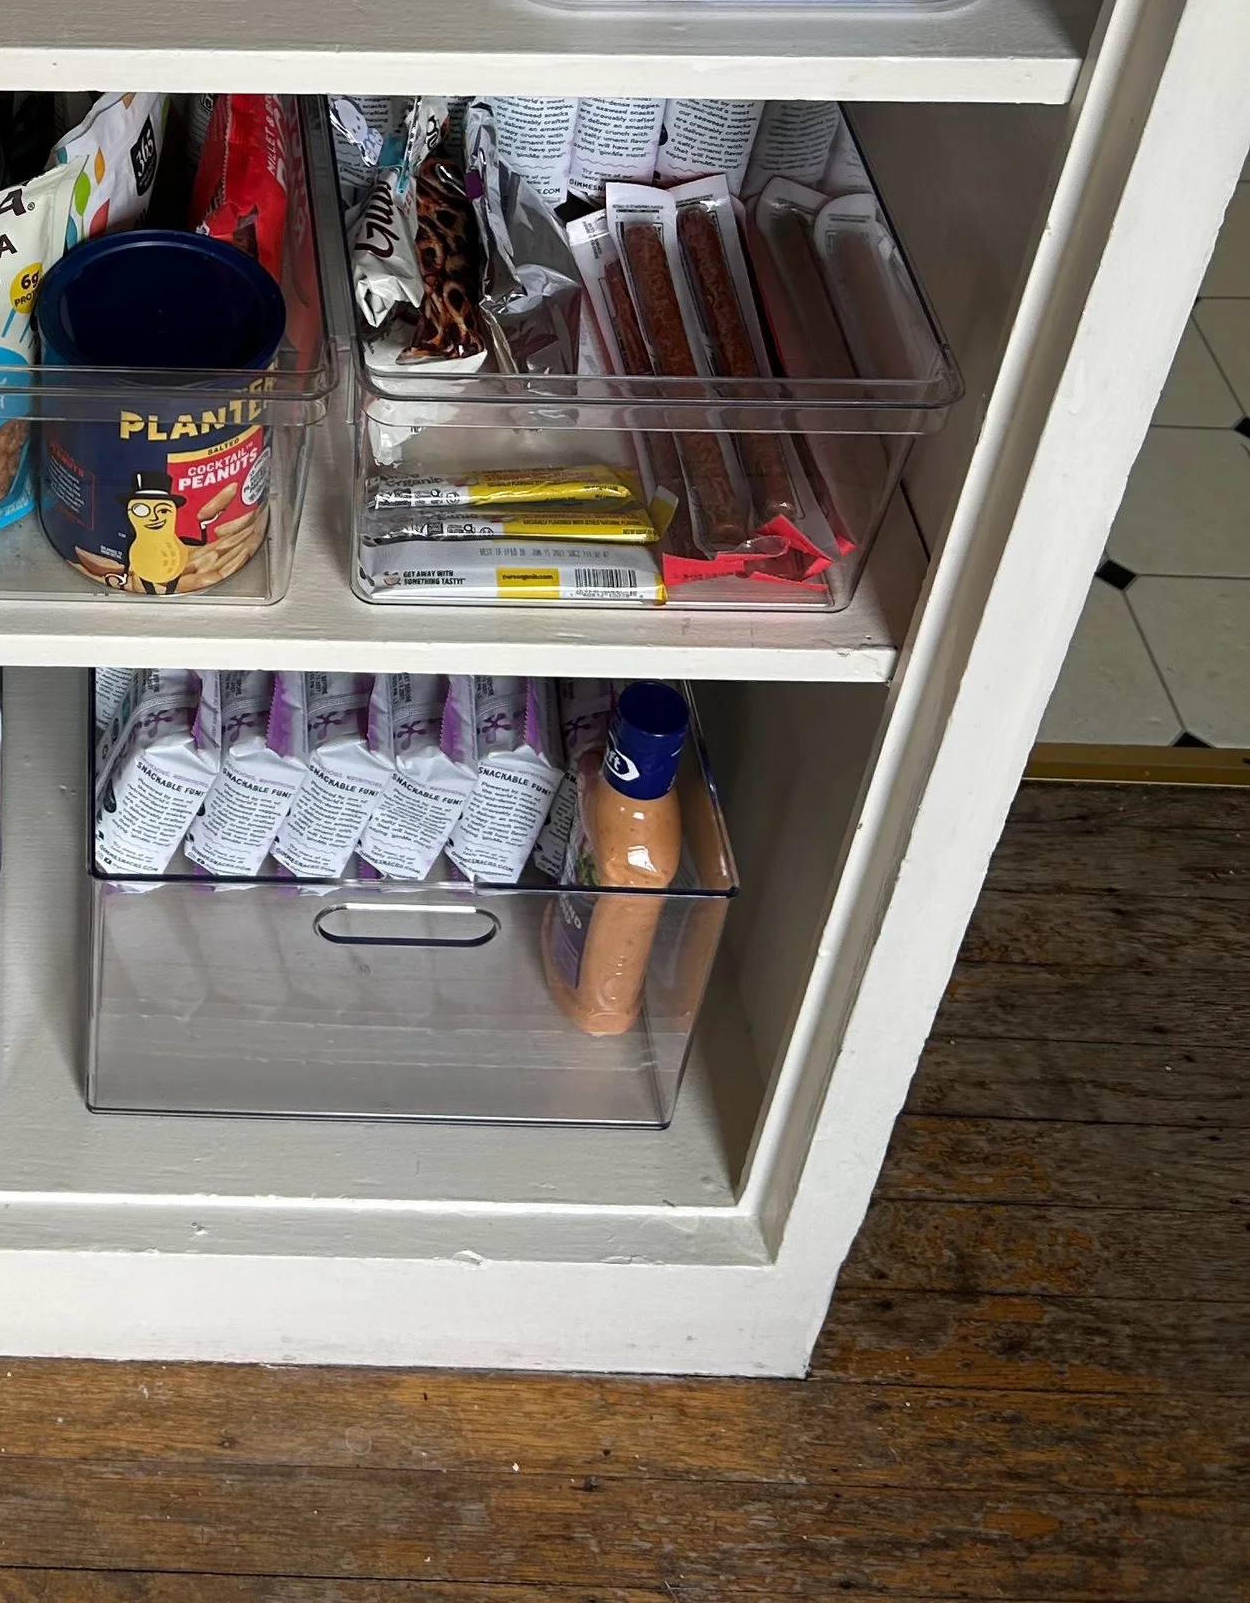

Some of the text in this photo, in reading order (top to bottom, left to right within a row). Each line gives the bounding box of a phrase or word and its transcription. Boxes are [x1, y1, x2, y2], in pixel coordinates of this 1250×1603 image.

[207, 437, 240, 456] SALTED
[178, 446, 258, 492] PEANUTS
[187, 447, 248, 477] COCKTAIL
[136, 761, 182, 792] SNACKABLE
[222, 767, 270, 794] SNACKABLE
[308, 764, 356, 793] SNACKABLE
[391, 773, 439, 802] SNACKABLE
[478, 766, 529, 788] SNACKABLE
